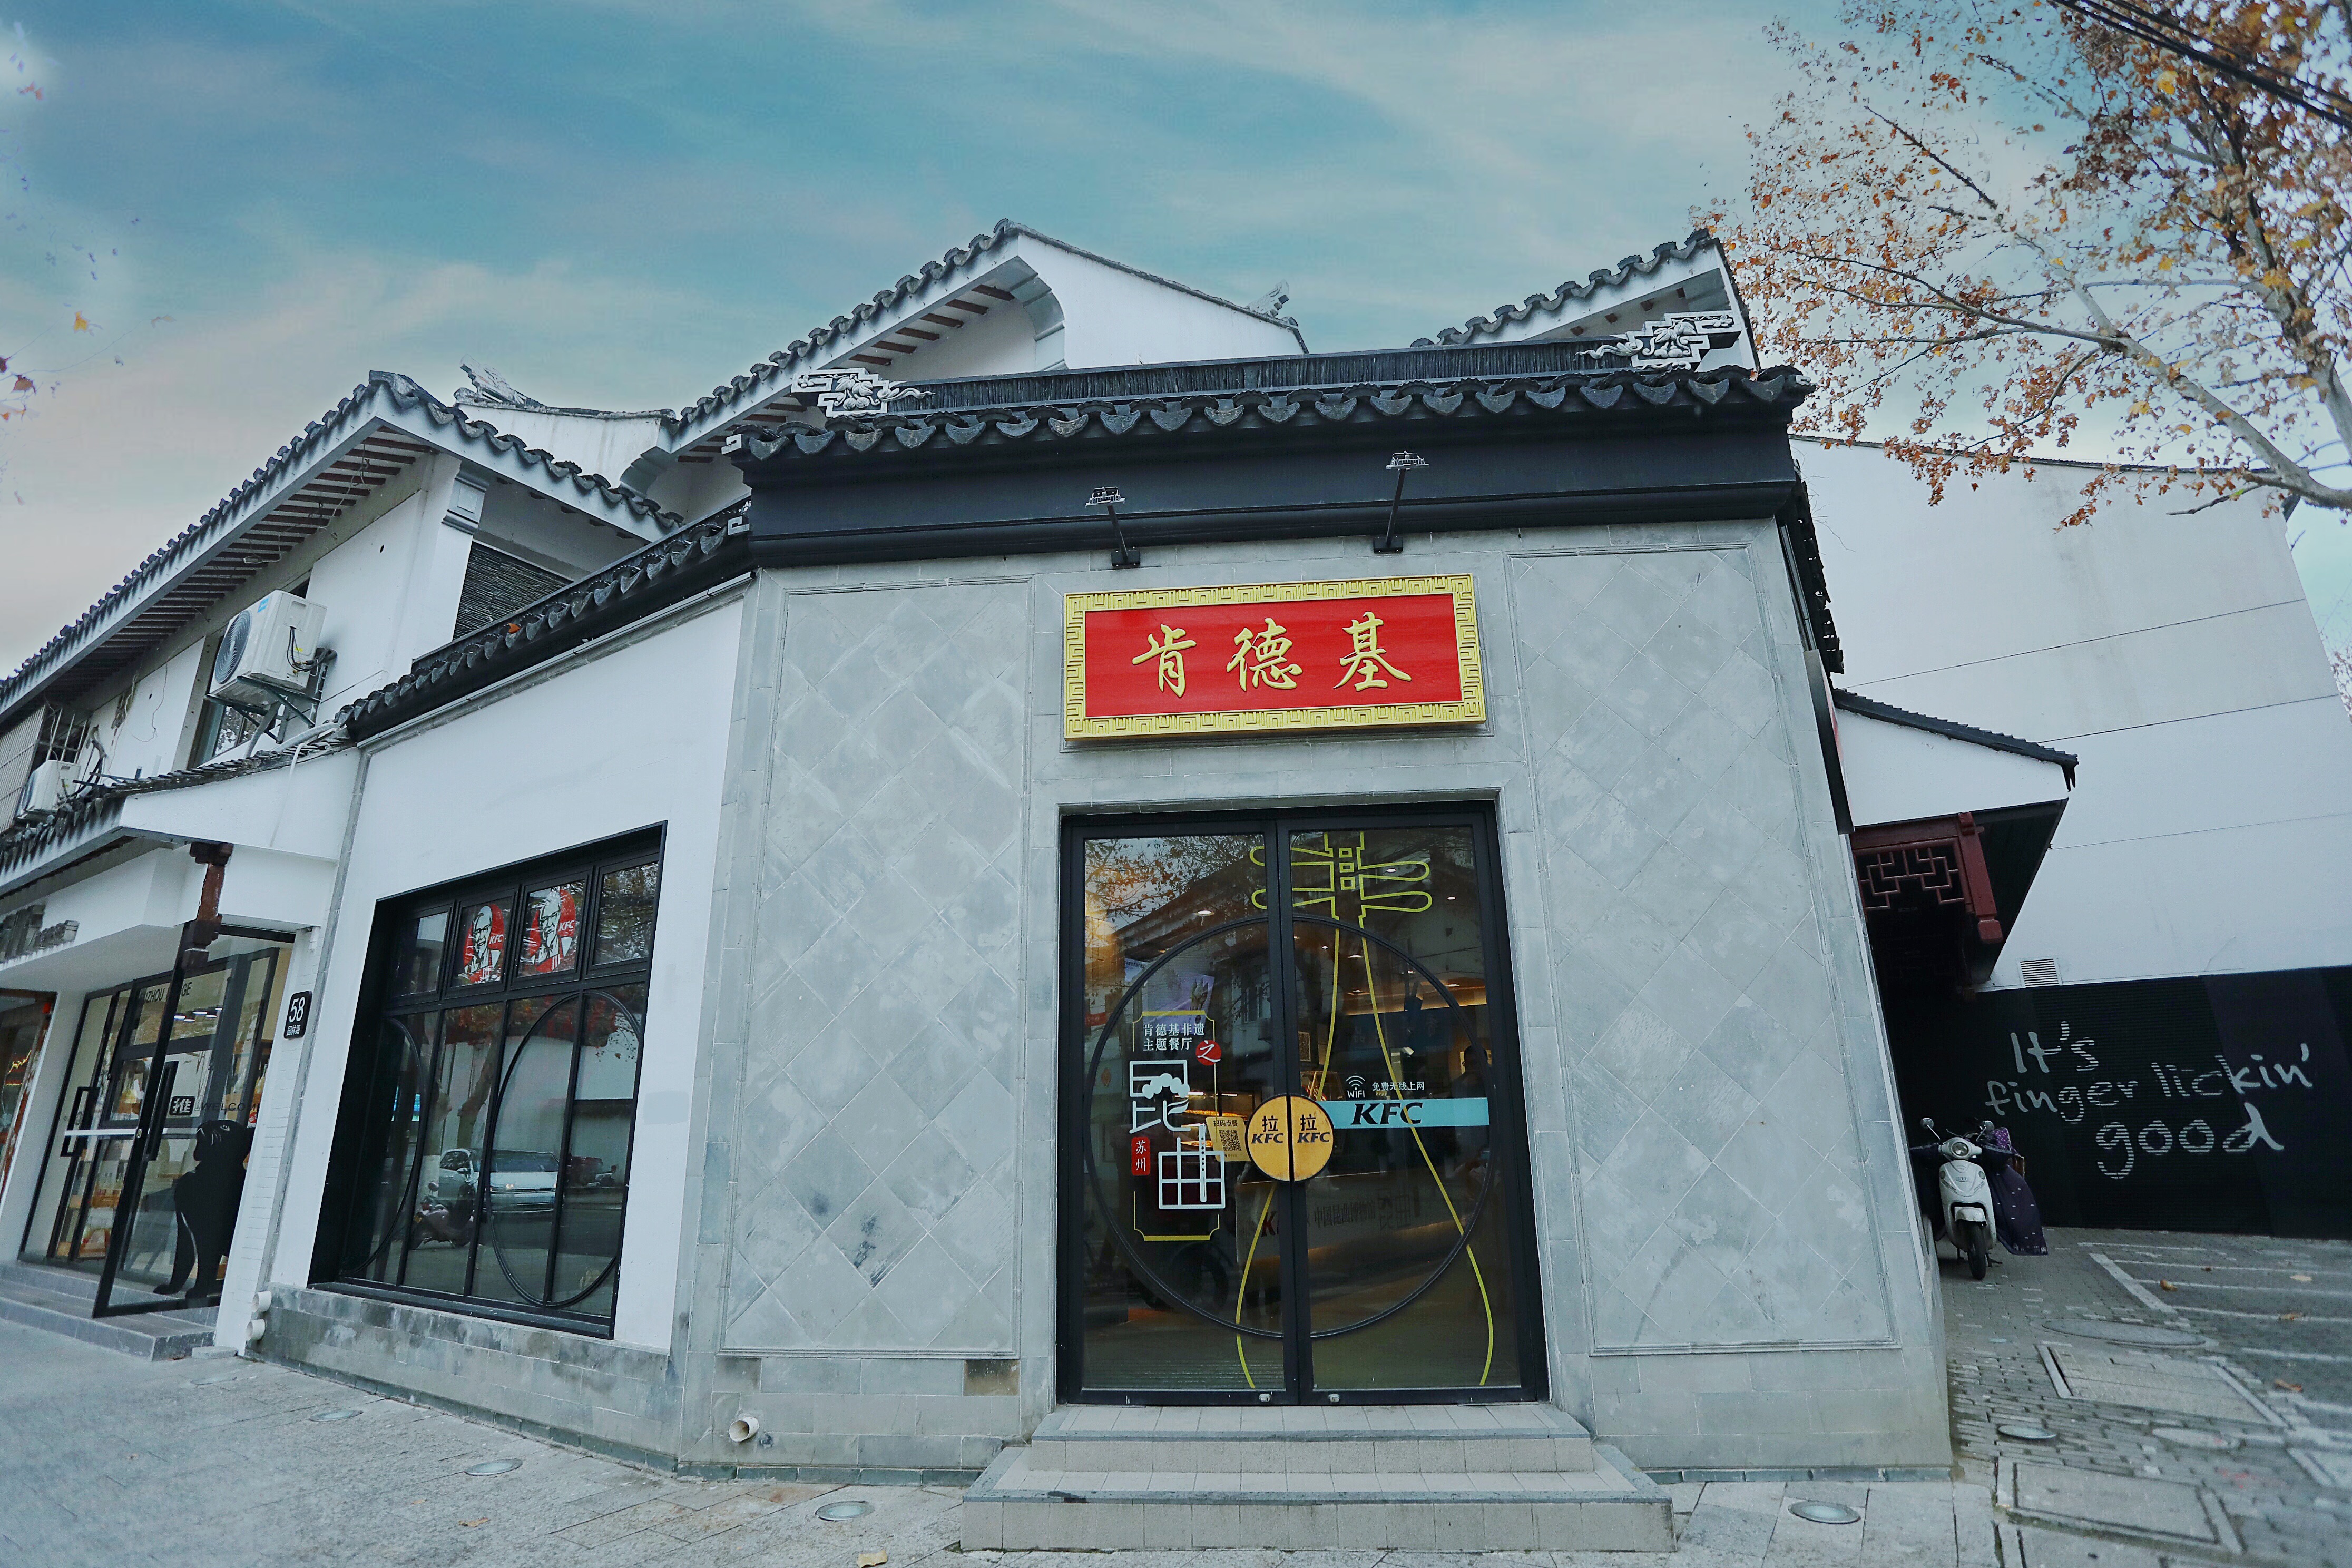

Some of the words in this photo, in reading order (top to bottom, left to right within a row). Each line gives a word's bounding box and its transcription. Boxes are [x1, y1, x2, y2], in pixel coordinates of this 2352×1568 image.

[1132, 611, 1412, 698] 肯德基
[558, 920, 575, 932] KFC
[489, 934, 504, 945] KFC
[289, 997, 306, 1023] 58
[1143, 1023, 1205, 1037] 肯德基非遗
[1143, 1037, 1193, 1052] 主题餐厅
[1197, 1040, 1221, 1063] 之
[2010, 1021, 2099, 1073] It's
[1372, 1081, 1425, 1091] 免费无线上网
[1985, 1080, 2139, 1124] finger
[2151, 1043, 2312, 1097] lickin'
[173, 1097, 192, 1113] 推
[1350, 1102, 1423, 1125] KFC
[1262, 1115, 1279, 1132] 拉
[1300, 1114, 1317, 1131] 拉
[1251, 1133, 1284, 1144] KFC
[1297, 1132, 1330, 1143] KFC
[2095, 1102, 2285, 1179] good
[1135, 1140, 1147, 1172] 苏州
